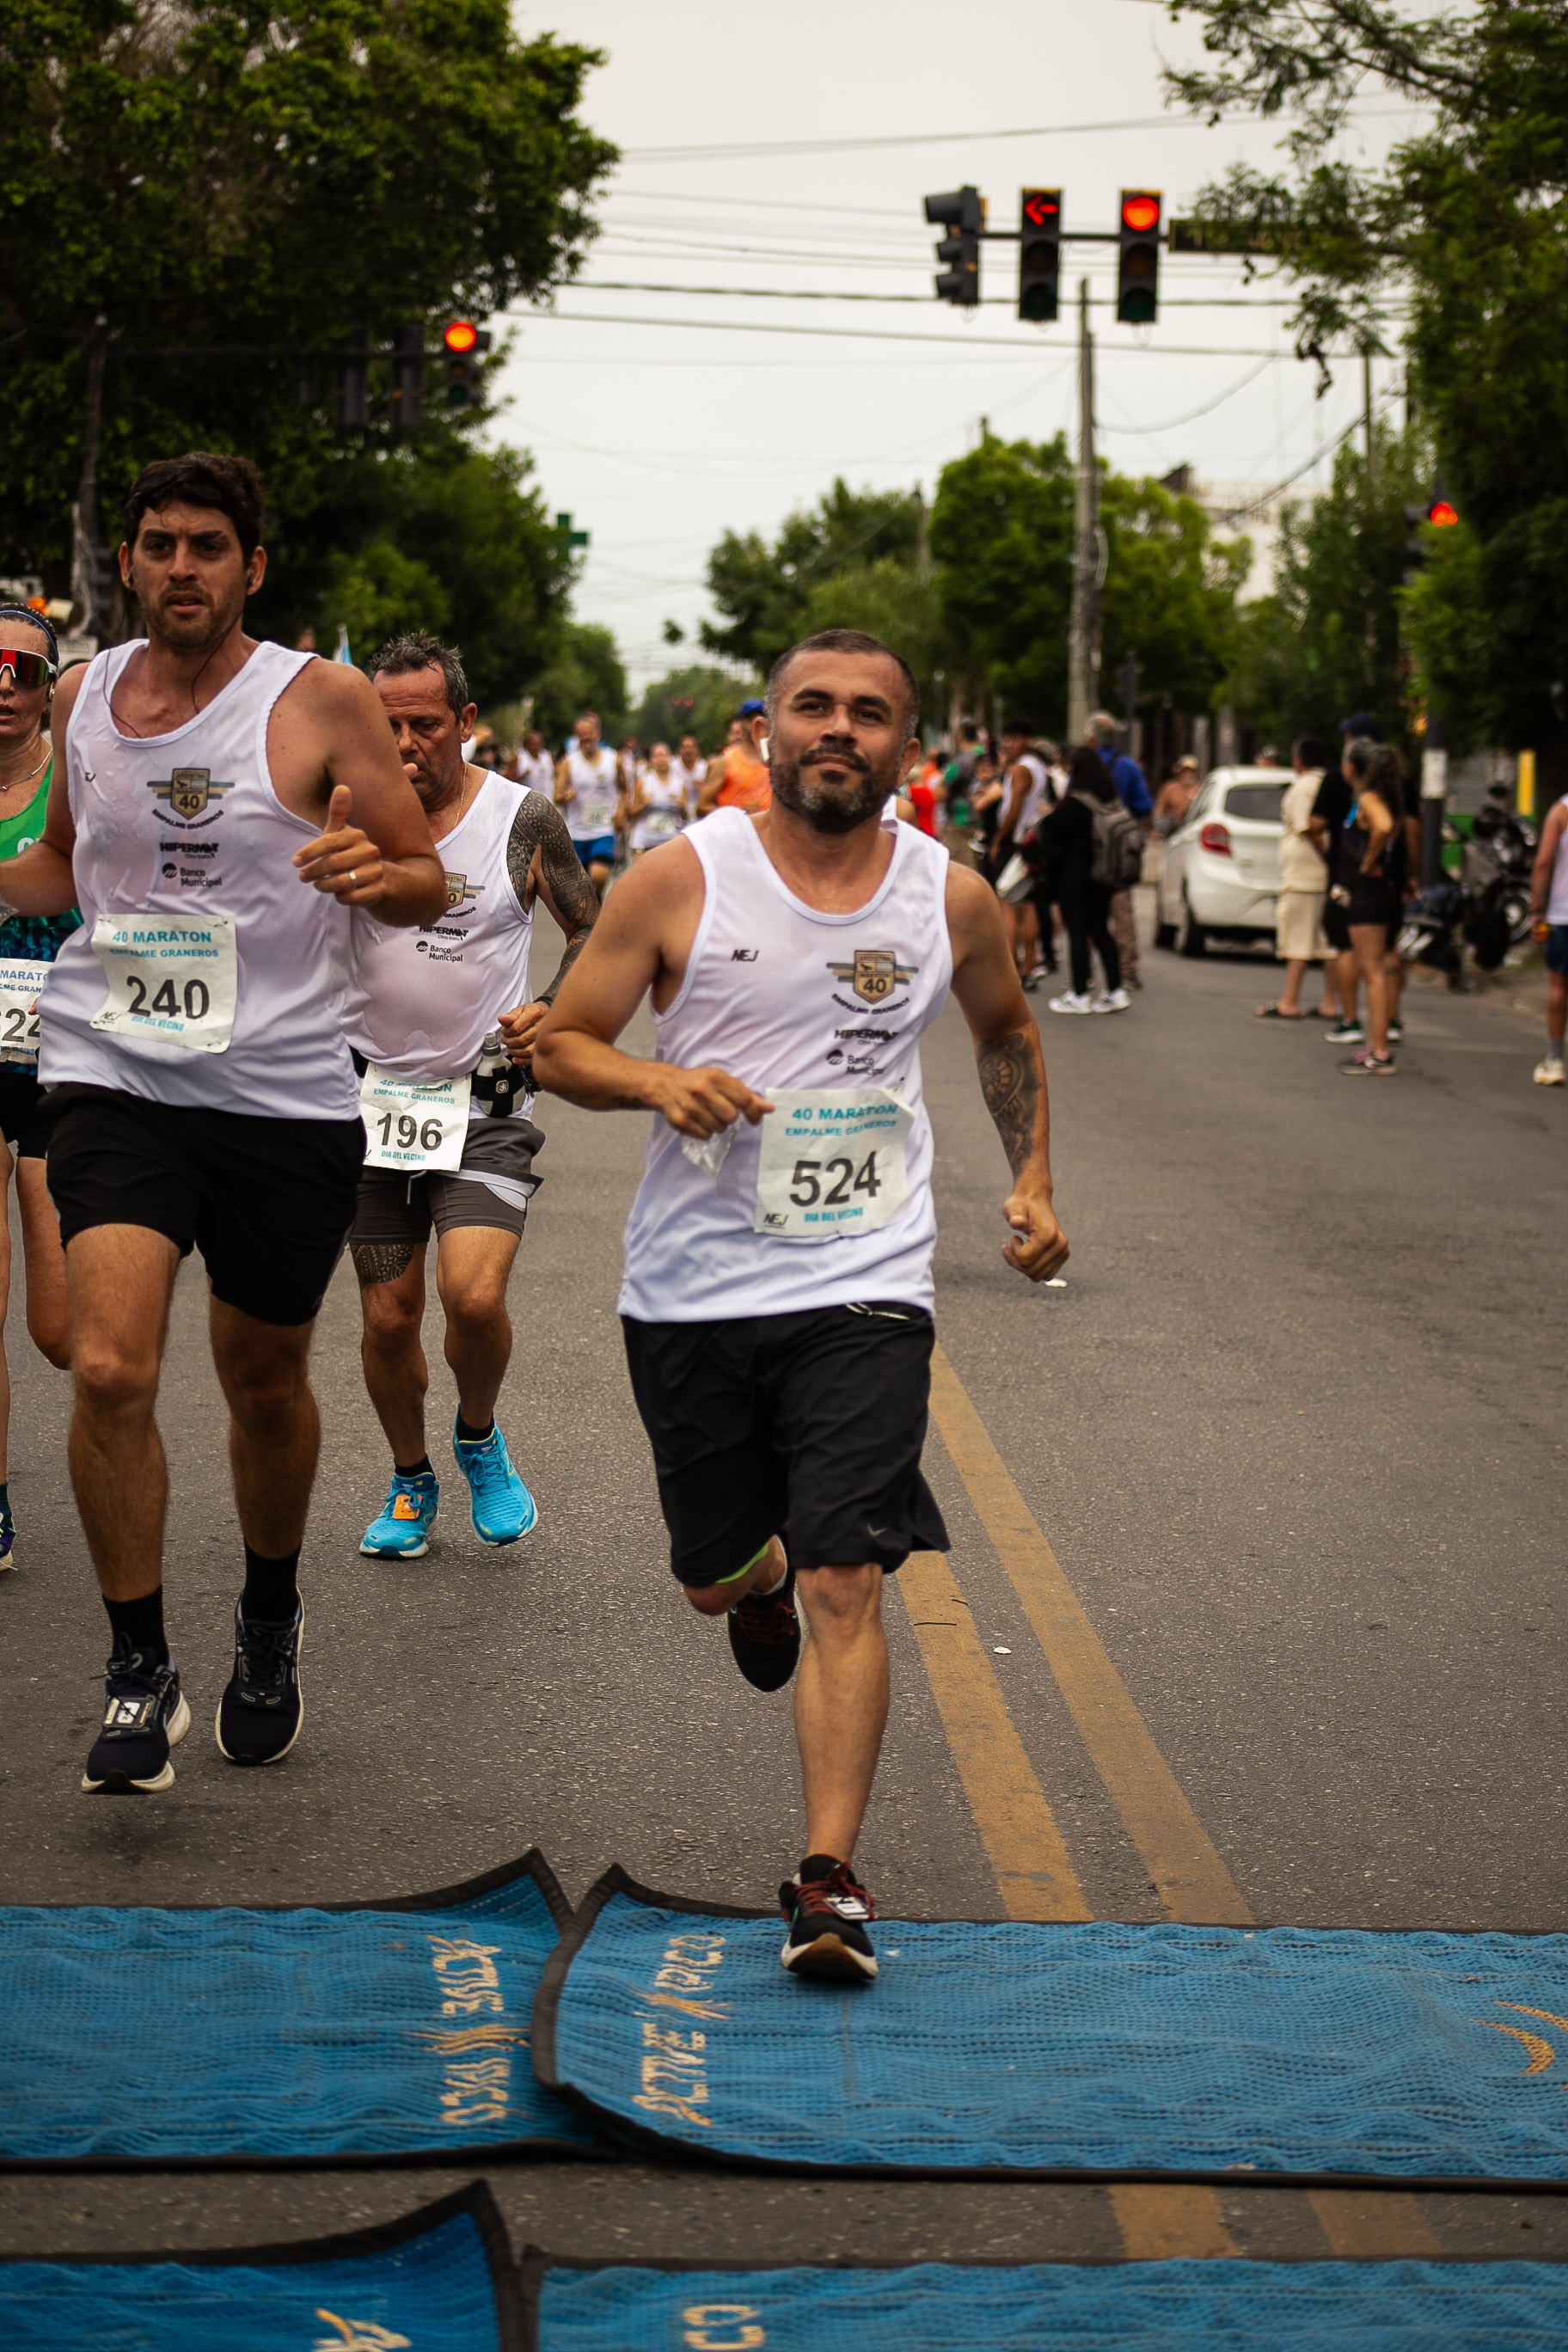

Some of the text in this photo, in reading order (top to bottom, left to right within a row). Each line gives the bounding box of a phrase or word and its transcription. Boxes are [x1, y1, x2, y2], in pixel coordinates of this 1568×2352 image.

[178, 794, 200, 810] 40
[151, 808, 224, 830] EMPALME GRANEROS
[180, 867, 206, 878] Banco
[181, 878, 223, 889] Municipal
[443, 906, 477, 918] GRANEROS
[113, 930, 212, 943] 40 MARATON
[109, 948, 219, 959] EMPALME GRANEROS
[430, 945, 452, 954] Banco
[731, 949, 760, 962] NEJ
[428, 952, 463, 964] Municipal
[863, 978, 887, 994] 40
[126, 975, 210, 1020] 240
[831, 993, 870, 1014] EMPALME
[144, 1017, 157, 1026] DEL
[157, 1020, 186, 1032] VECINO
[847, 1056, 875, 1066] Banco
[373, 1087, 456, 1105] EMPALME GRANEROS
[792, 1104, 898, 1121] 40 MARATON
[377, 1112, 444, 1151] 196
[785, 1127, 842, 1136] EMPALME
[381, 1149, 392, 1158] DIA
[392, 1151, 402, 1161] DEL
[402, 1152, 426, 1161] VECINO
[788, 1150, 882, 1207] 524
[763, 1212, 789, 1227] NEJ
